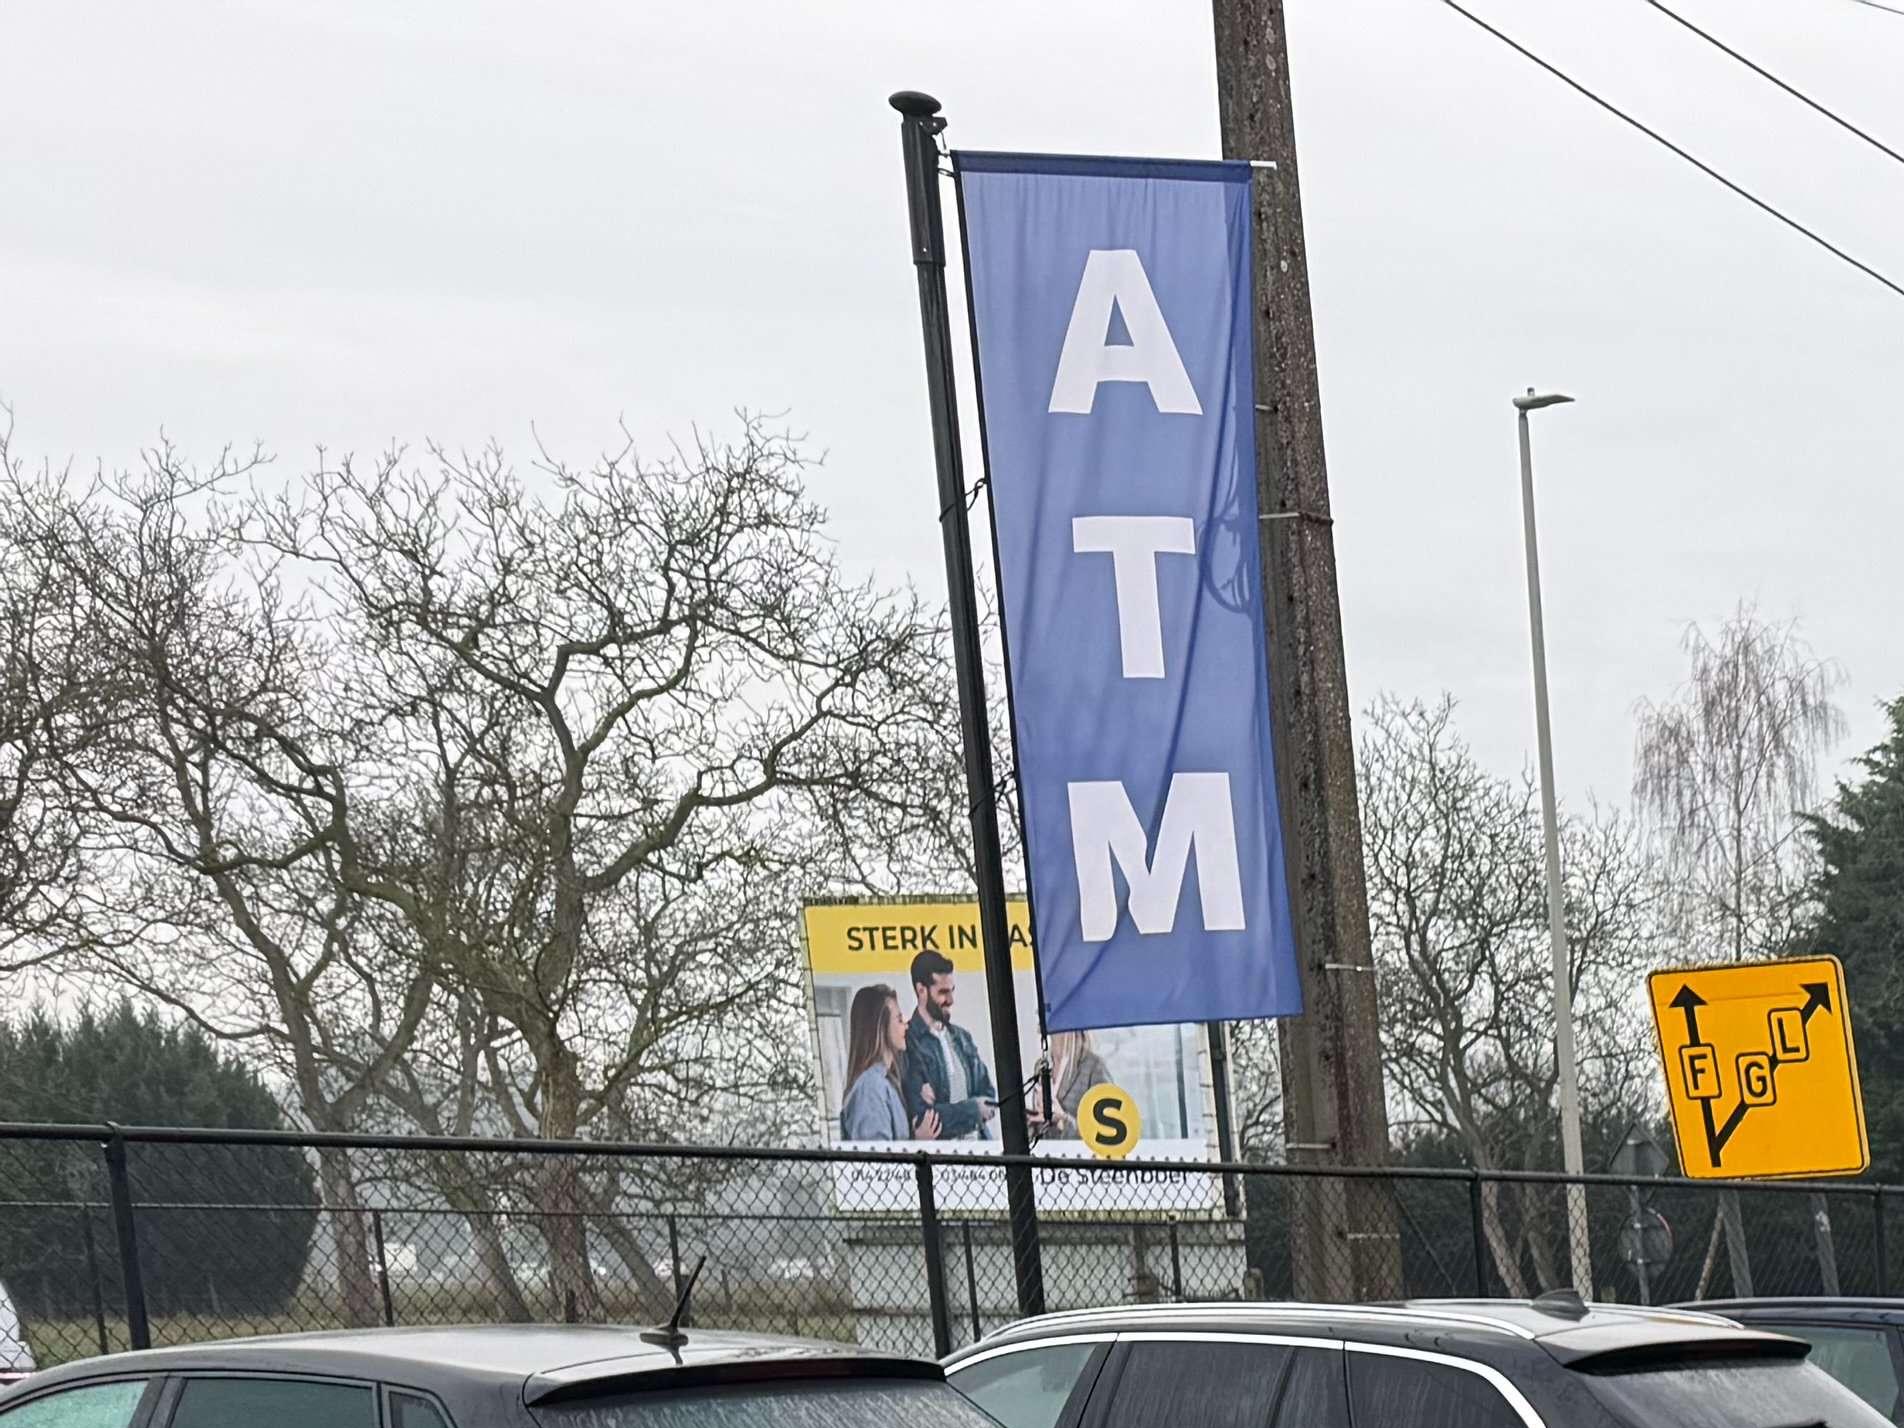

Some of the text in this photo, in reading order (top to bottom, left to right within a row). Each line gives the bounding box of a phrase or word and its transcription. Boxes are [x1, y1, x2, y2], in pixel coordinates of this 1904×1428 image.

[846, 924, 940, 951] STERK
[949, 924, 978, 949] IN
[1777, 1017, 1801, 1053] L
[1688, 1053, 1708, 1091] F
[1744, 1061, 1768, 1098] G
[1093, 1098, 1128, 1147] S
